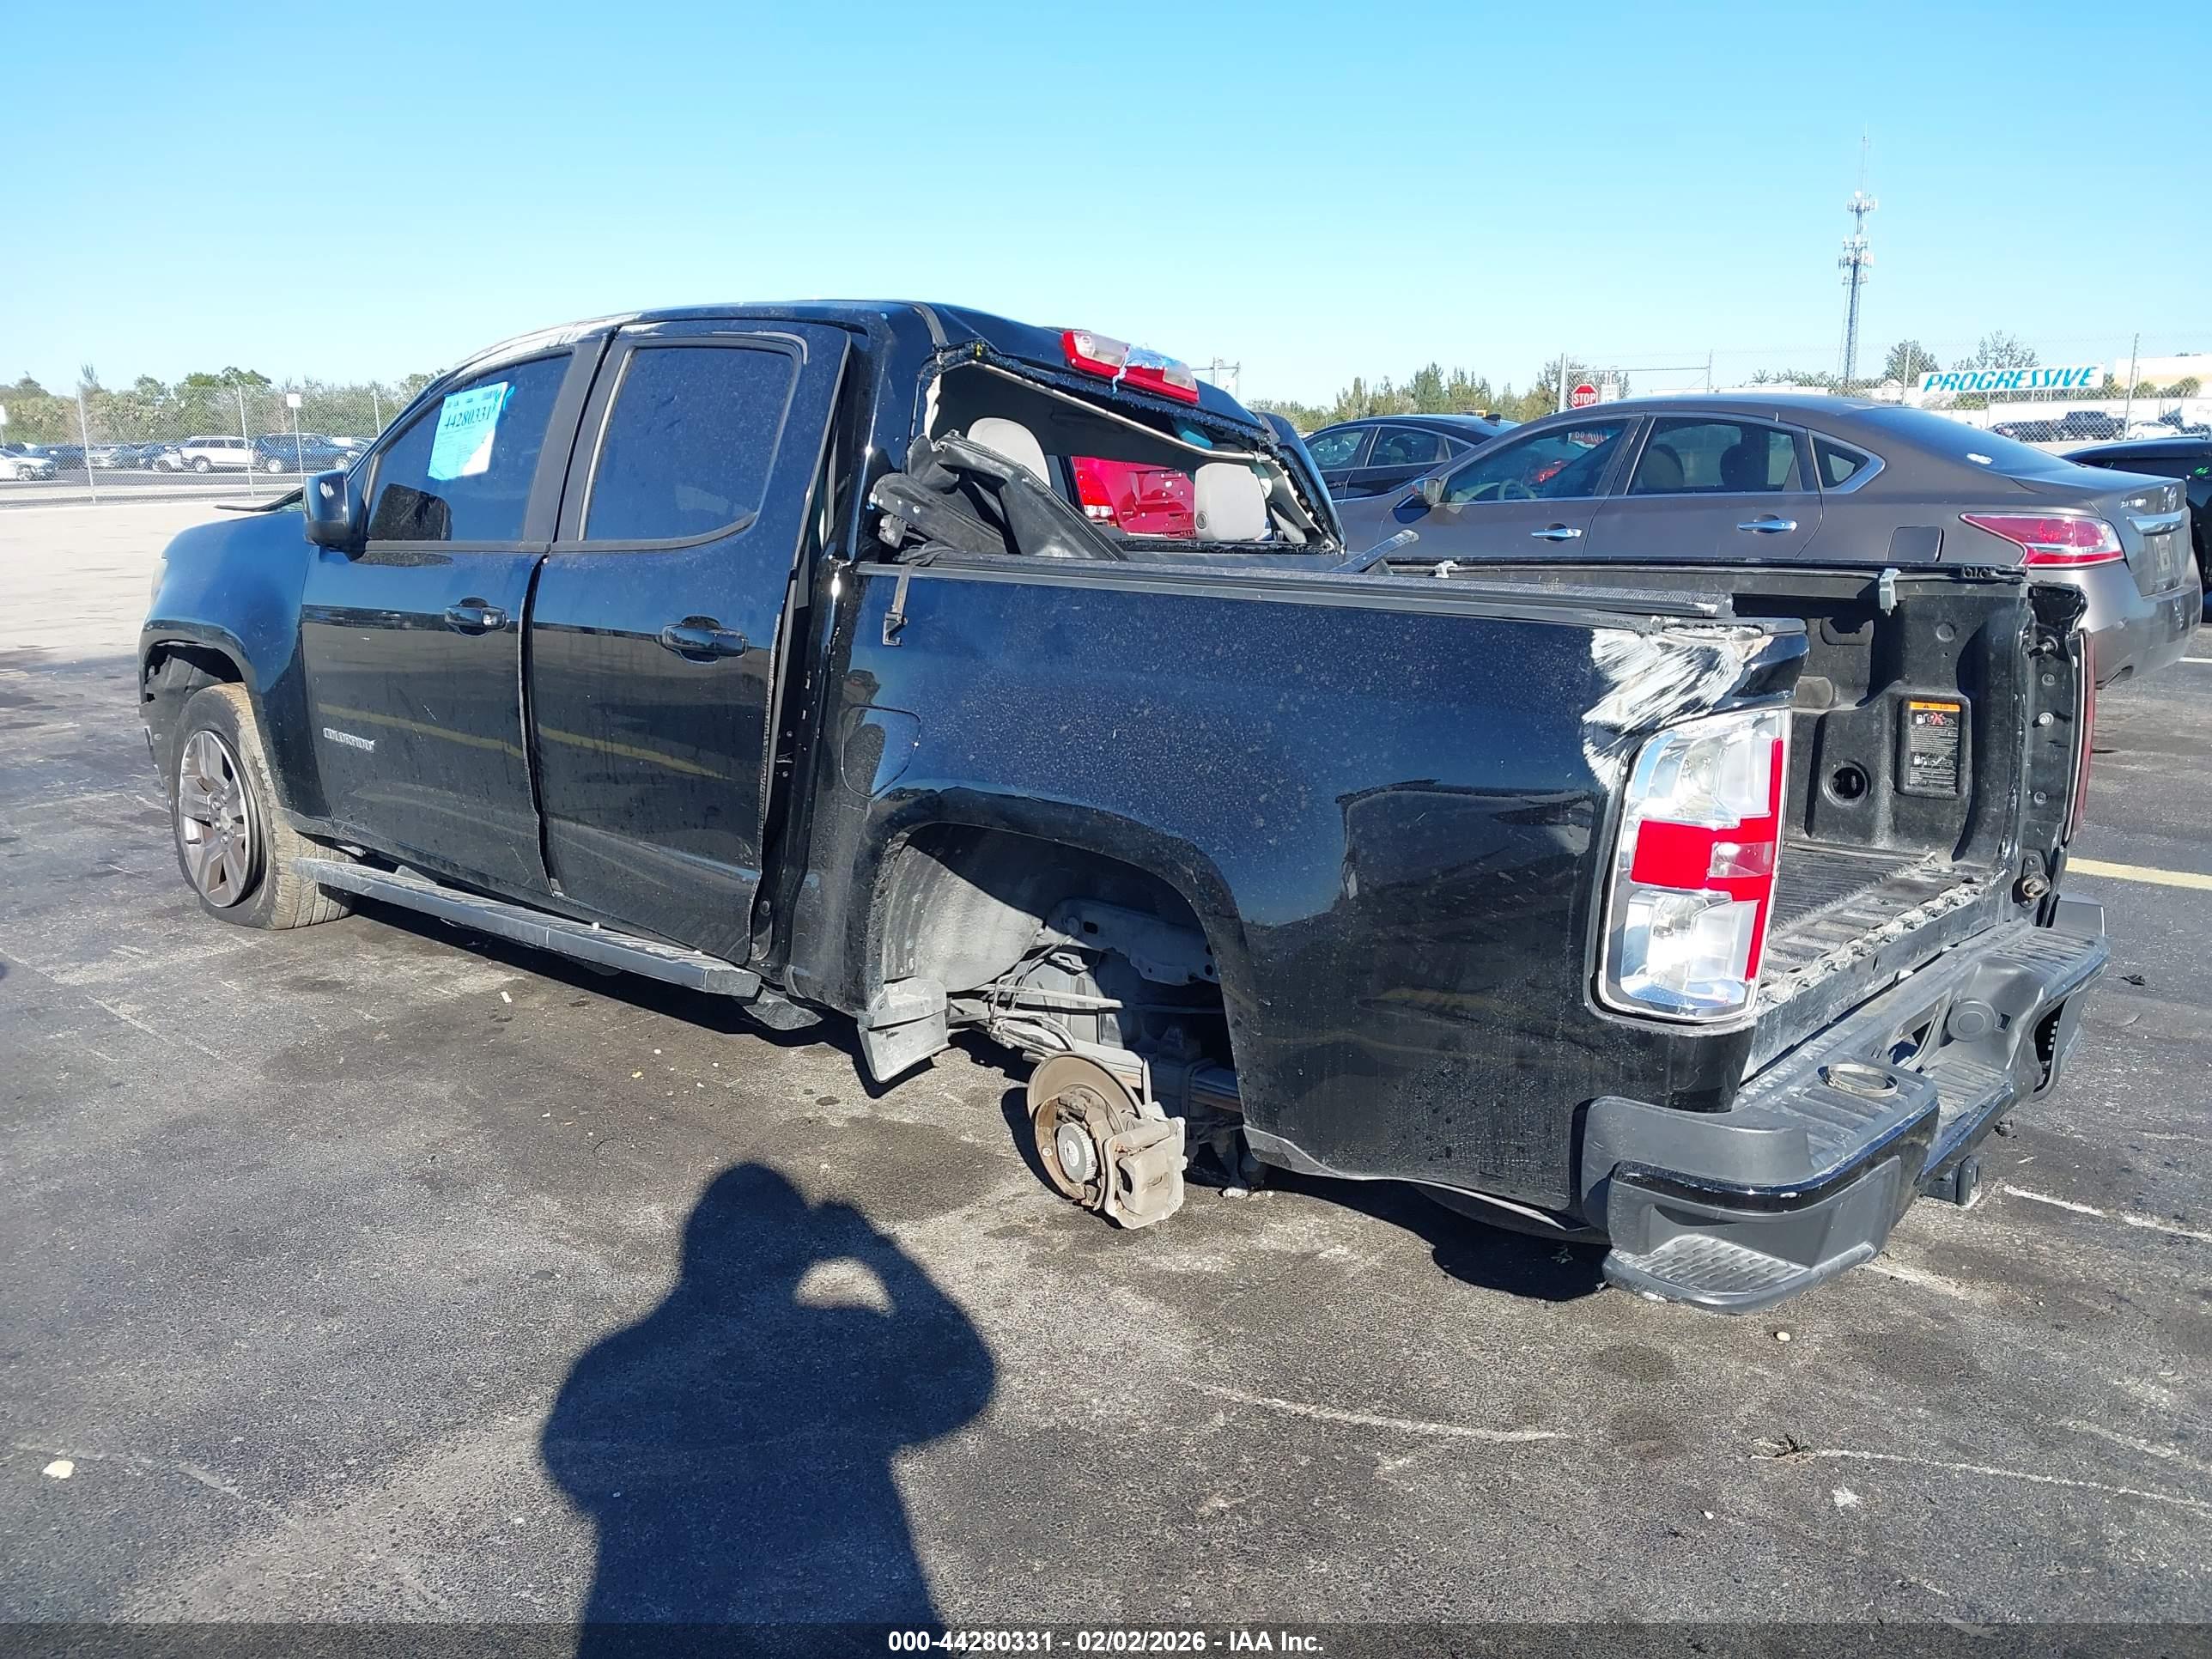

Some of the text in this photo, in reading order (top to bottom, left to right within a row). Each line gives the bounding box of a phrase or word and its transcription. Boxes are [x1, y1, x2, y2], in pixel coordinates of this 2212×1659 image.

[1923, 366, 2098, 392] PROGRESSIVE
[1573, 392, 1596, 404] STOP
[444, 405, 492, 429] 44280331
